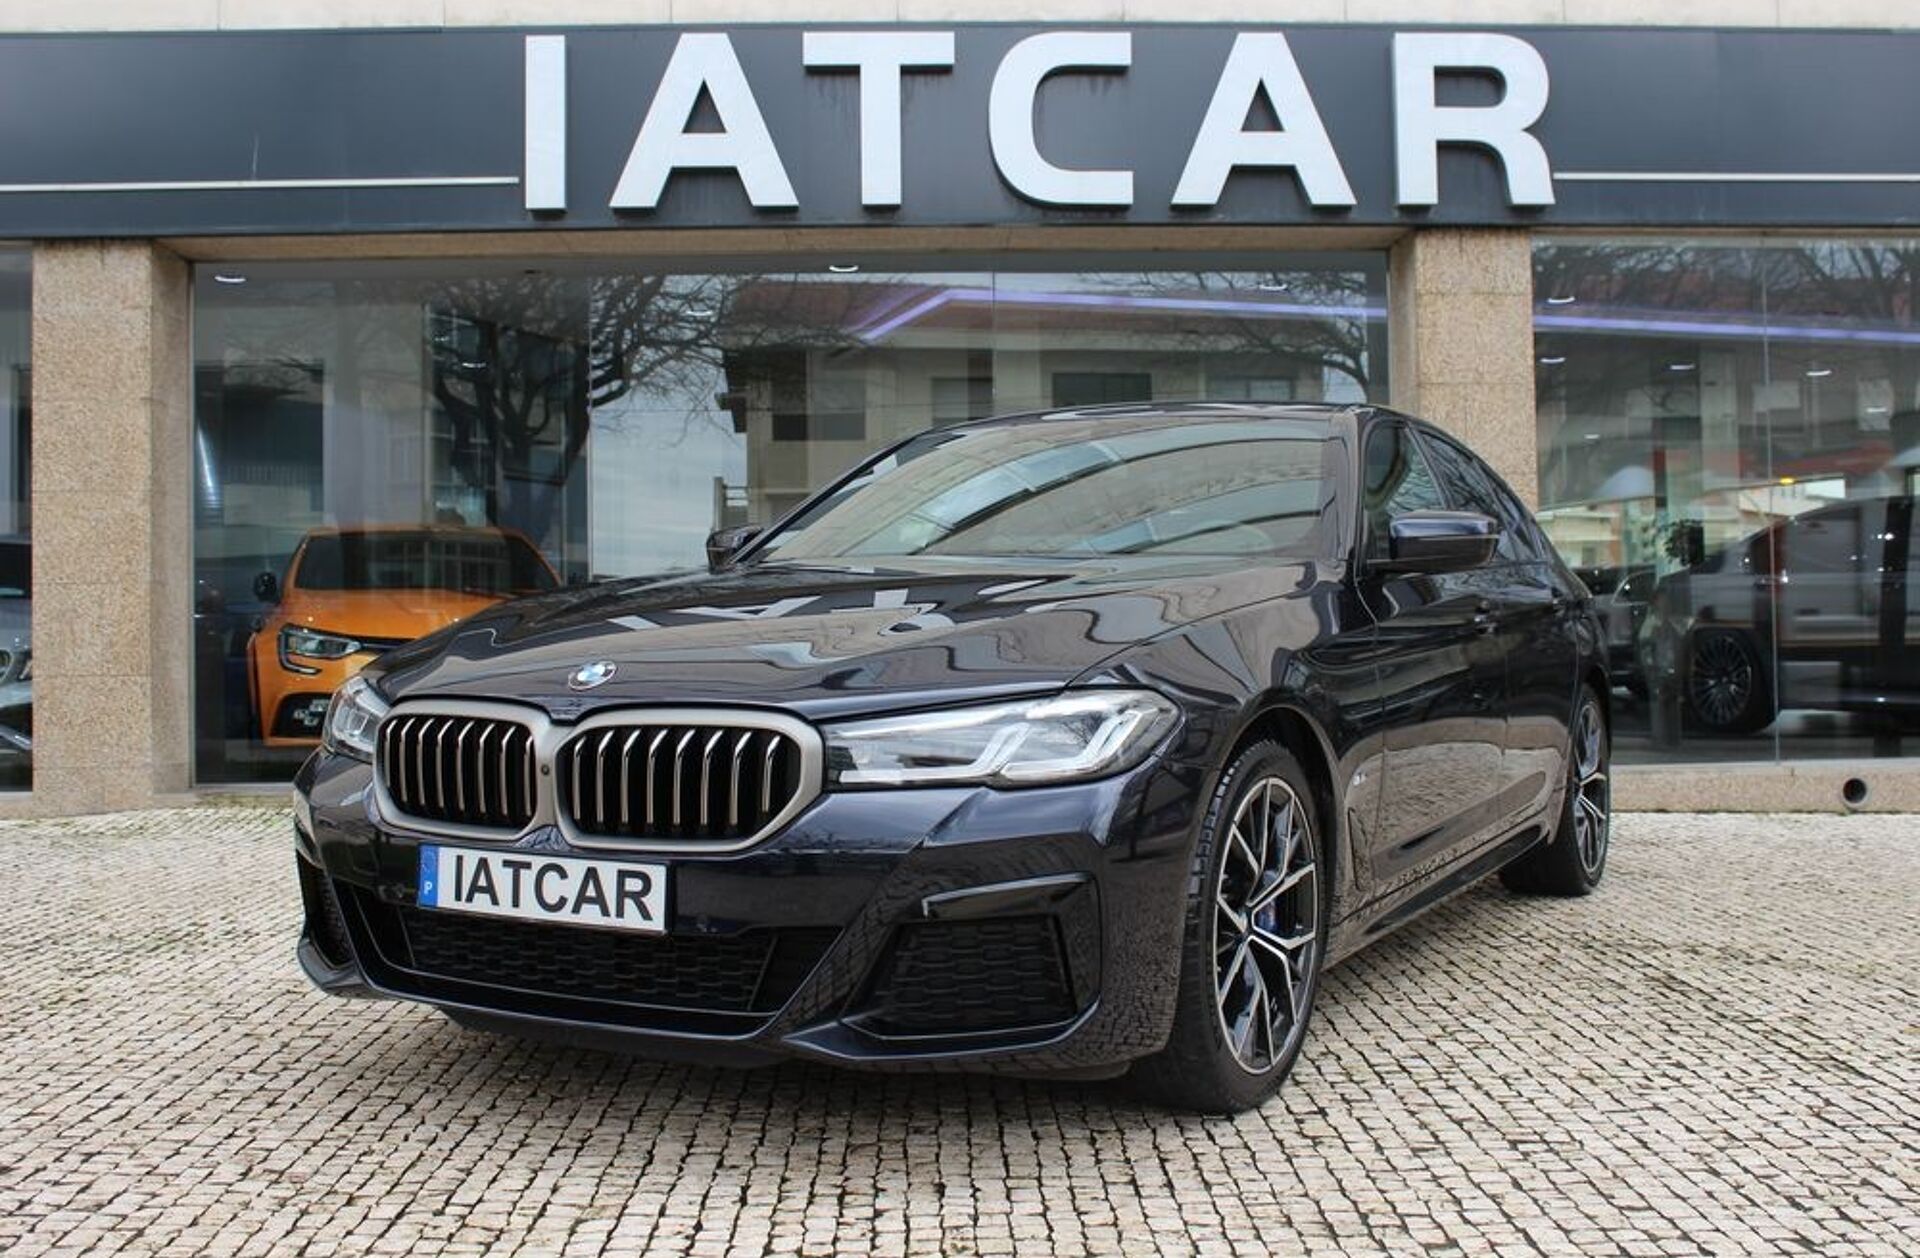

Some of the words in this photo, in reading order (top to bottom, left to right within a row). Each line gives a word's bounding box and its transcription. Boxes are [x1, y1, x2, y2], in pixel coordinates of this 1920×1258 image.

[524, 31, 1555, 211] IATCAR
[423, 881, 433, 895] P
[454, 854, 654, 922] IATCAR
